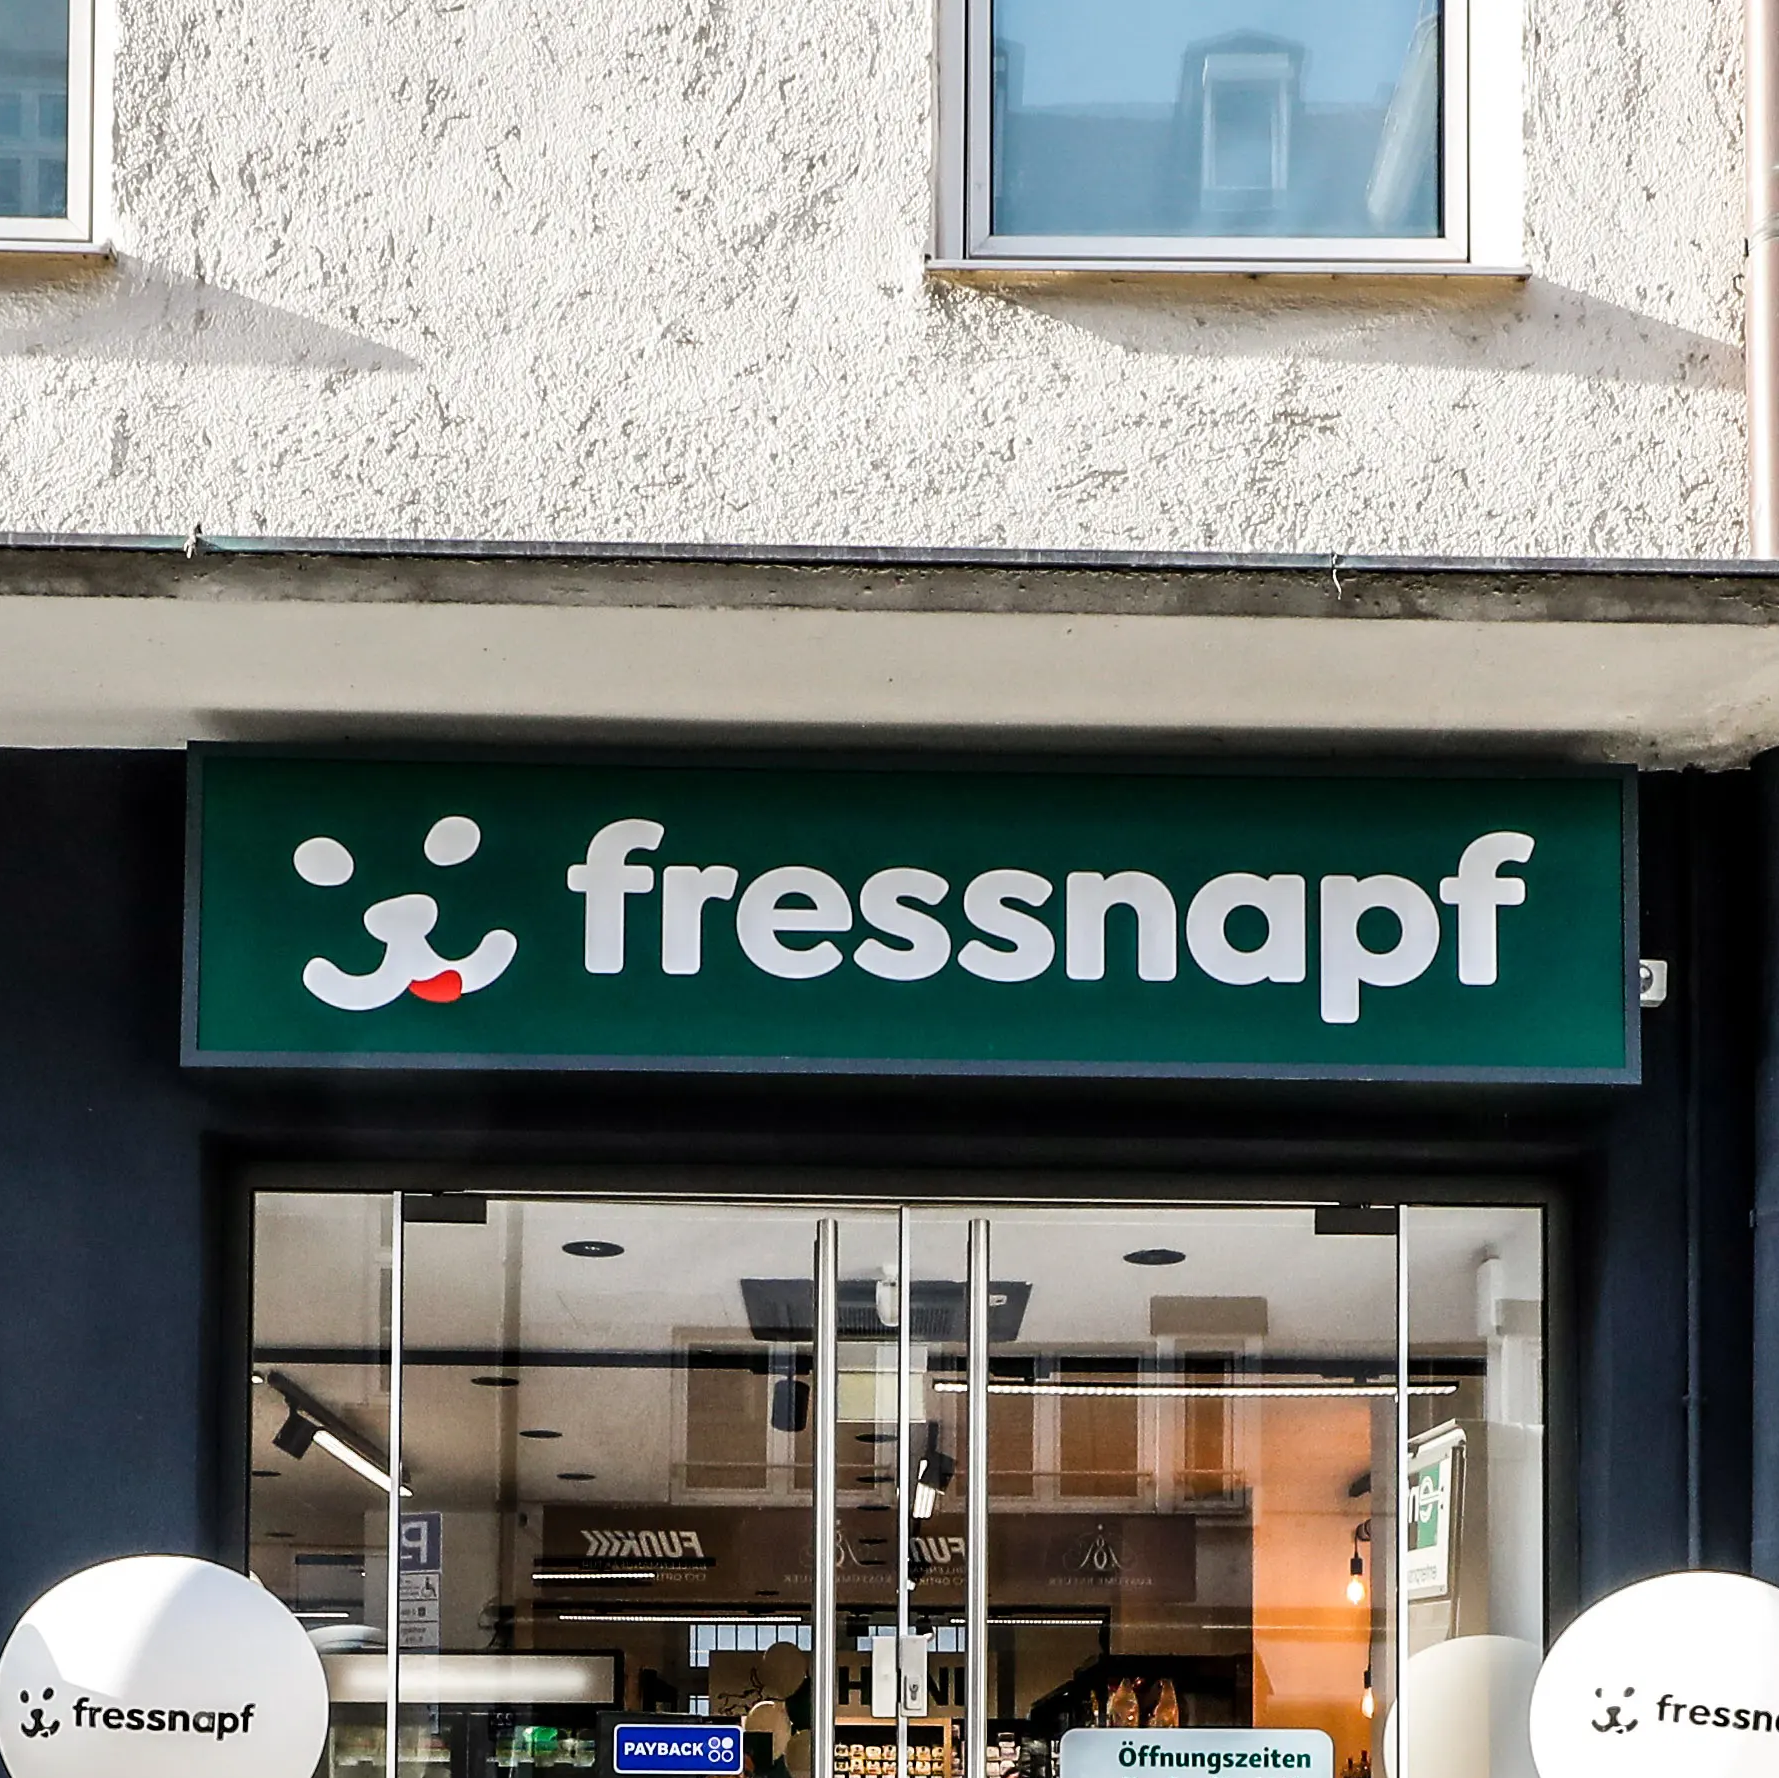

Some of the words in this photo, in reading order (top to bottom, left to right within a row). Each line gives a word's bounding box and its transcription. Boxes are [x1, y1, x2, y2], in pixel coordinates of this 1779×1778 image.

[568, 818, 1534, 1025] fressnapf
[73, 1696, 257, 1741] fressnapf
[624, 1741, 704, 1757] PAYBACK
[1118, 1741, 1312, 1774] Öffnungszeiten
